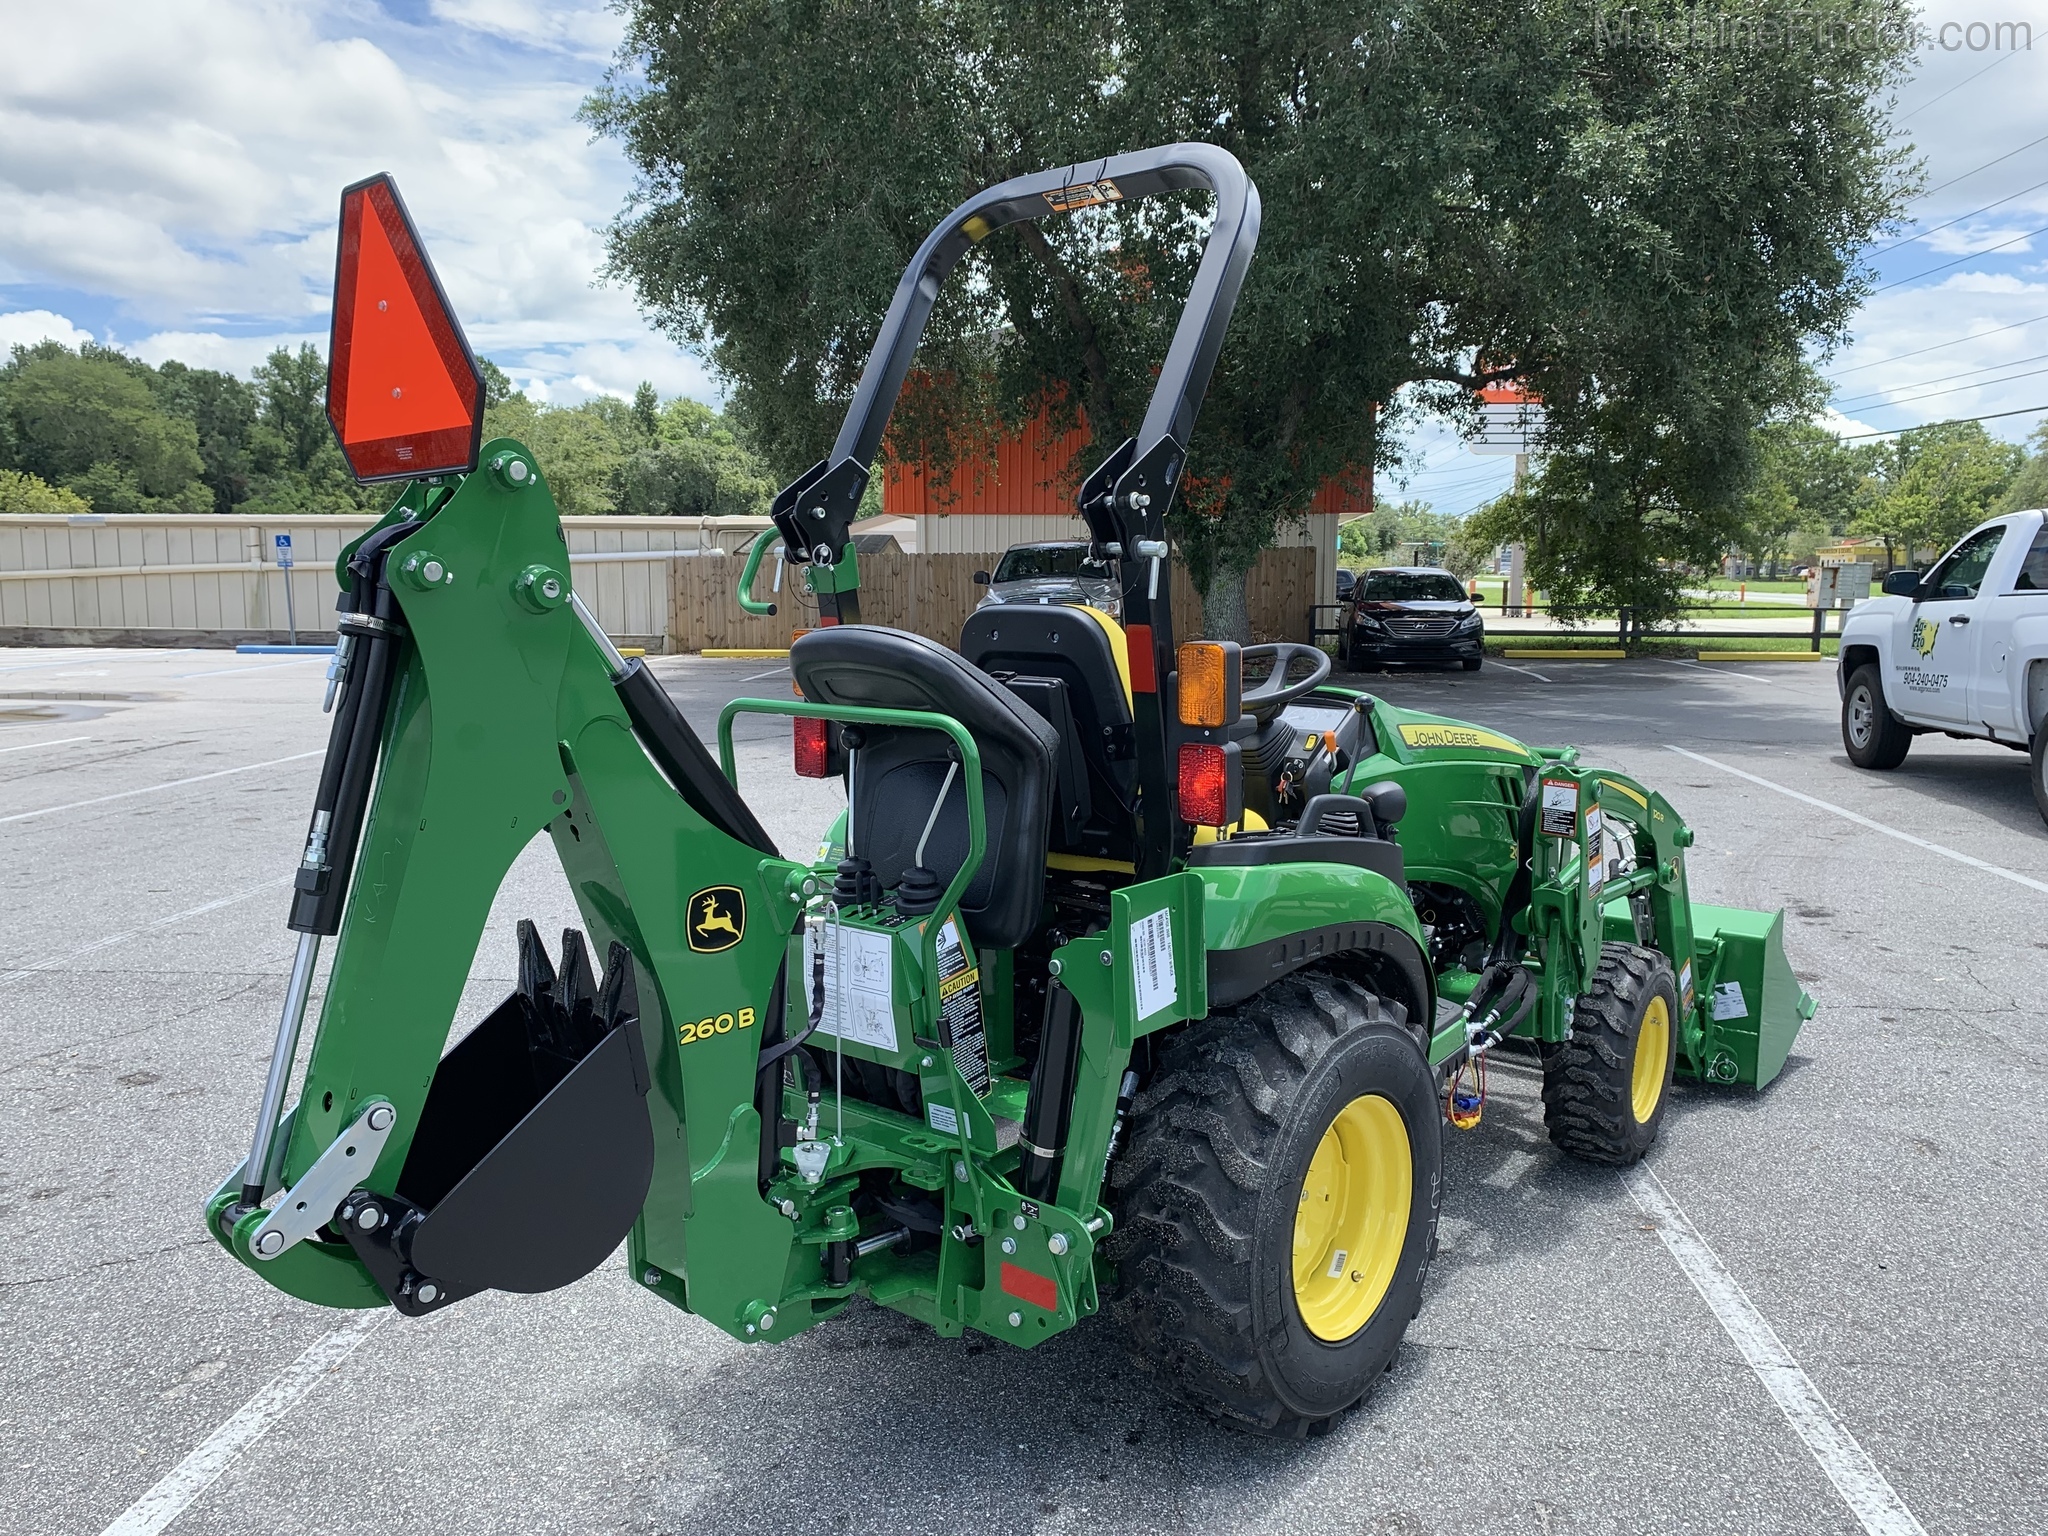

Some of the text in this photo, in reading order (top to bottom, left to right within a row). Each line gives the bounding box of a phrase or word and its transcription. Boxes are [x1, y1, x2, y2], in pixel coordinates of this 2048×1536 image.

[1911, 633, 1924, 648] Pro
[1903, 672, 1949, 688] 904-240-0475
[1413, 729, 1480, 746] JOHN DEERE
[1553, 781, 1575, 789] DANGER
[948, 972, 975, 993] CAUTION
[679, 1006, 756, 1046] 260 B
